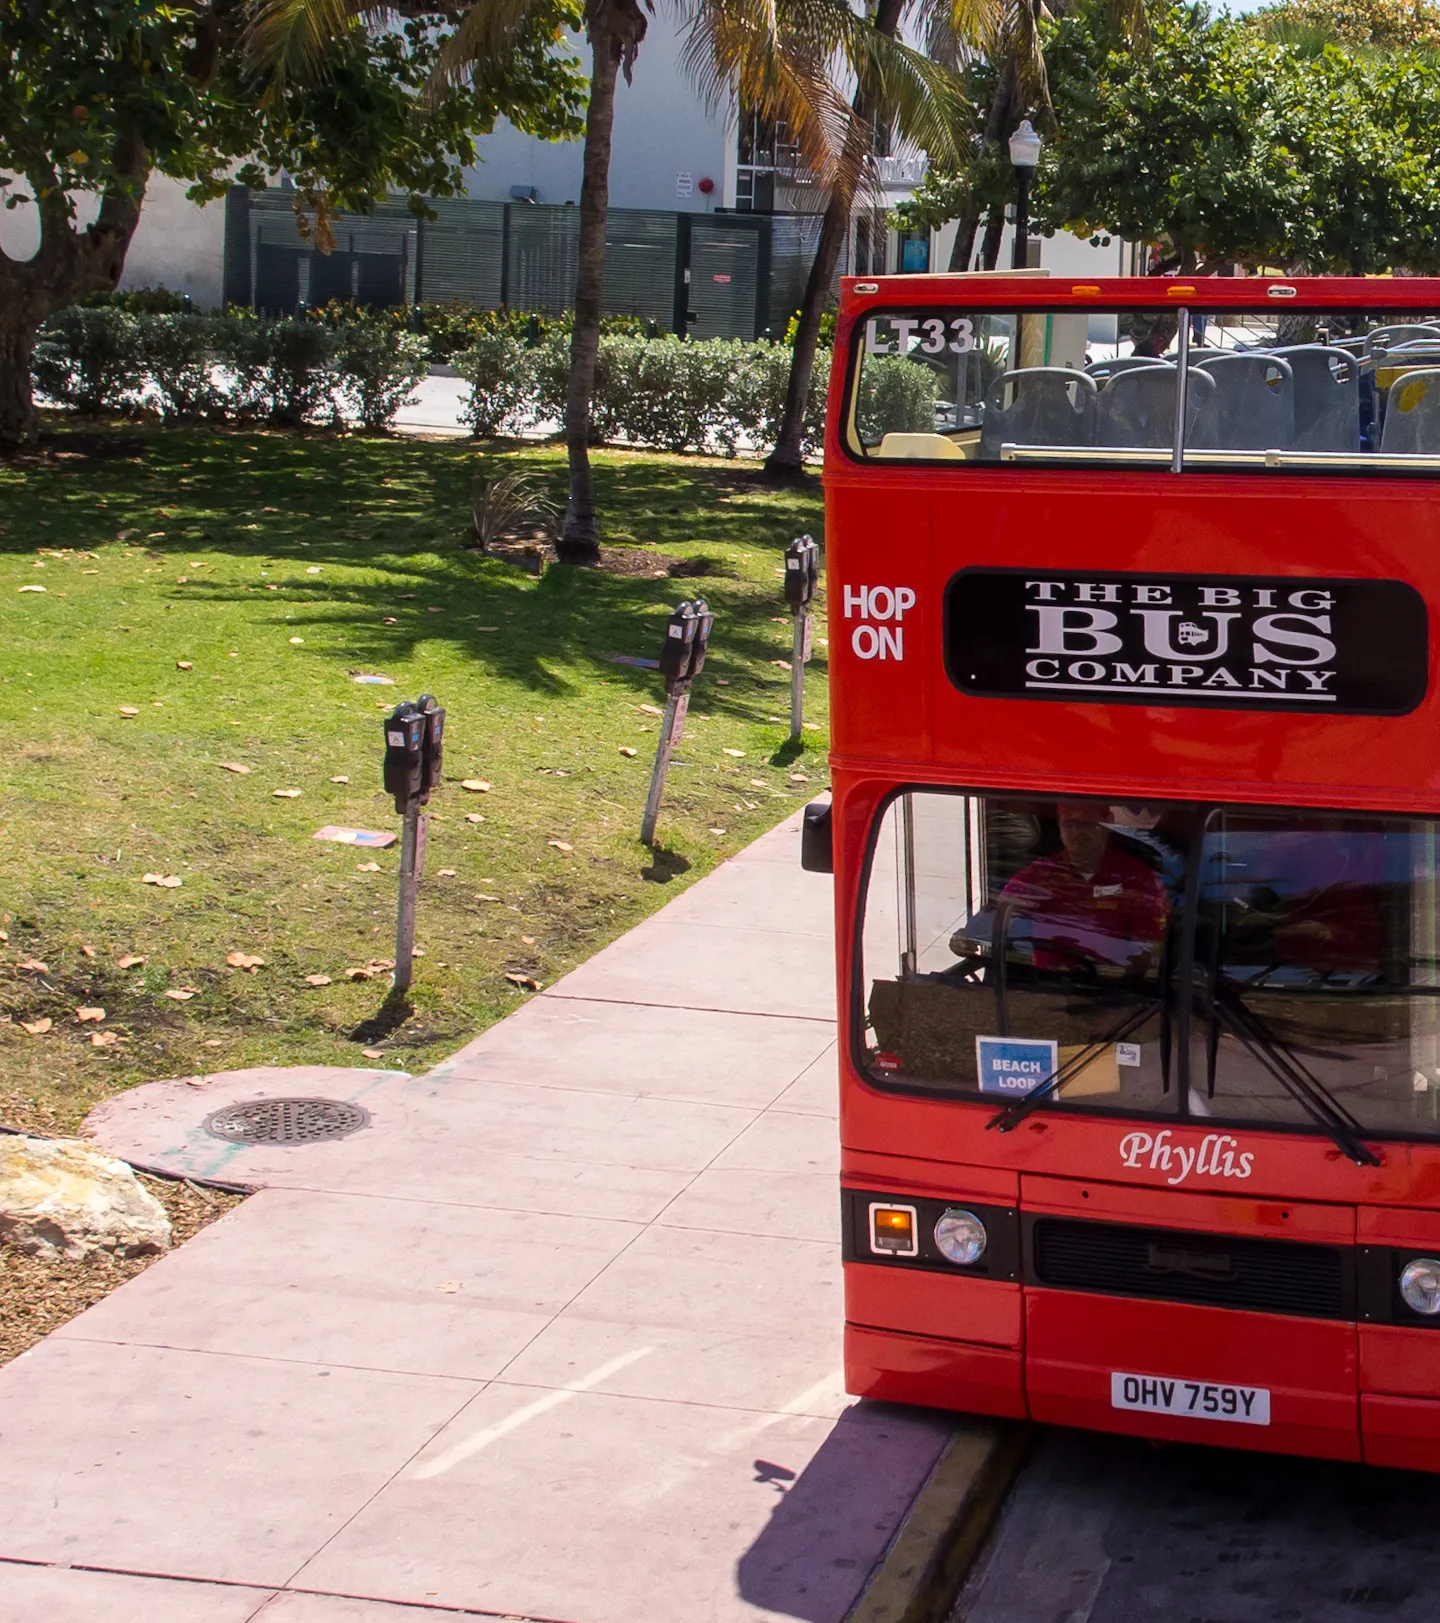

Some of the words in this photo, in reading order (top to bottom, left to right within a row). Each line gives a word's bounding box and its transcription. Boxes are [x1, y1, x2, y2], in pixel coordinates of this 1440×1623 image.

[865, 318, 974, 354] LT33
[843, 584, 916, 621] HOP
[1025, 581, 1172, 605] THE
[1198, 587, 1337, 610] BIG
[851, 624, 904, 661] ON
[1025, 604, 1337, 666] BUS
[1025, 659, 1337, 691] COMPANY
[992, 1059, 1041, 1074] BEACH
[998, 1076, 1036, 1090] LOOP
[1119, 1129, 1254, 1185] Phyllis
[1123, 1377, 1175, 1407] OHV
[1184, 1383, 1256, 1416] 759Y
